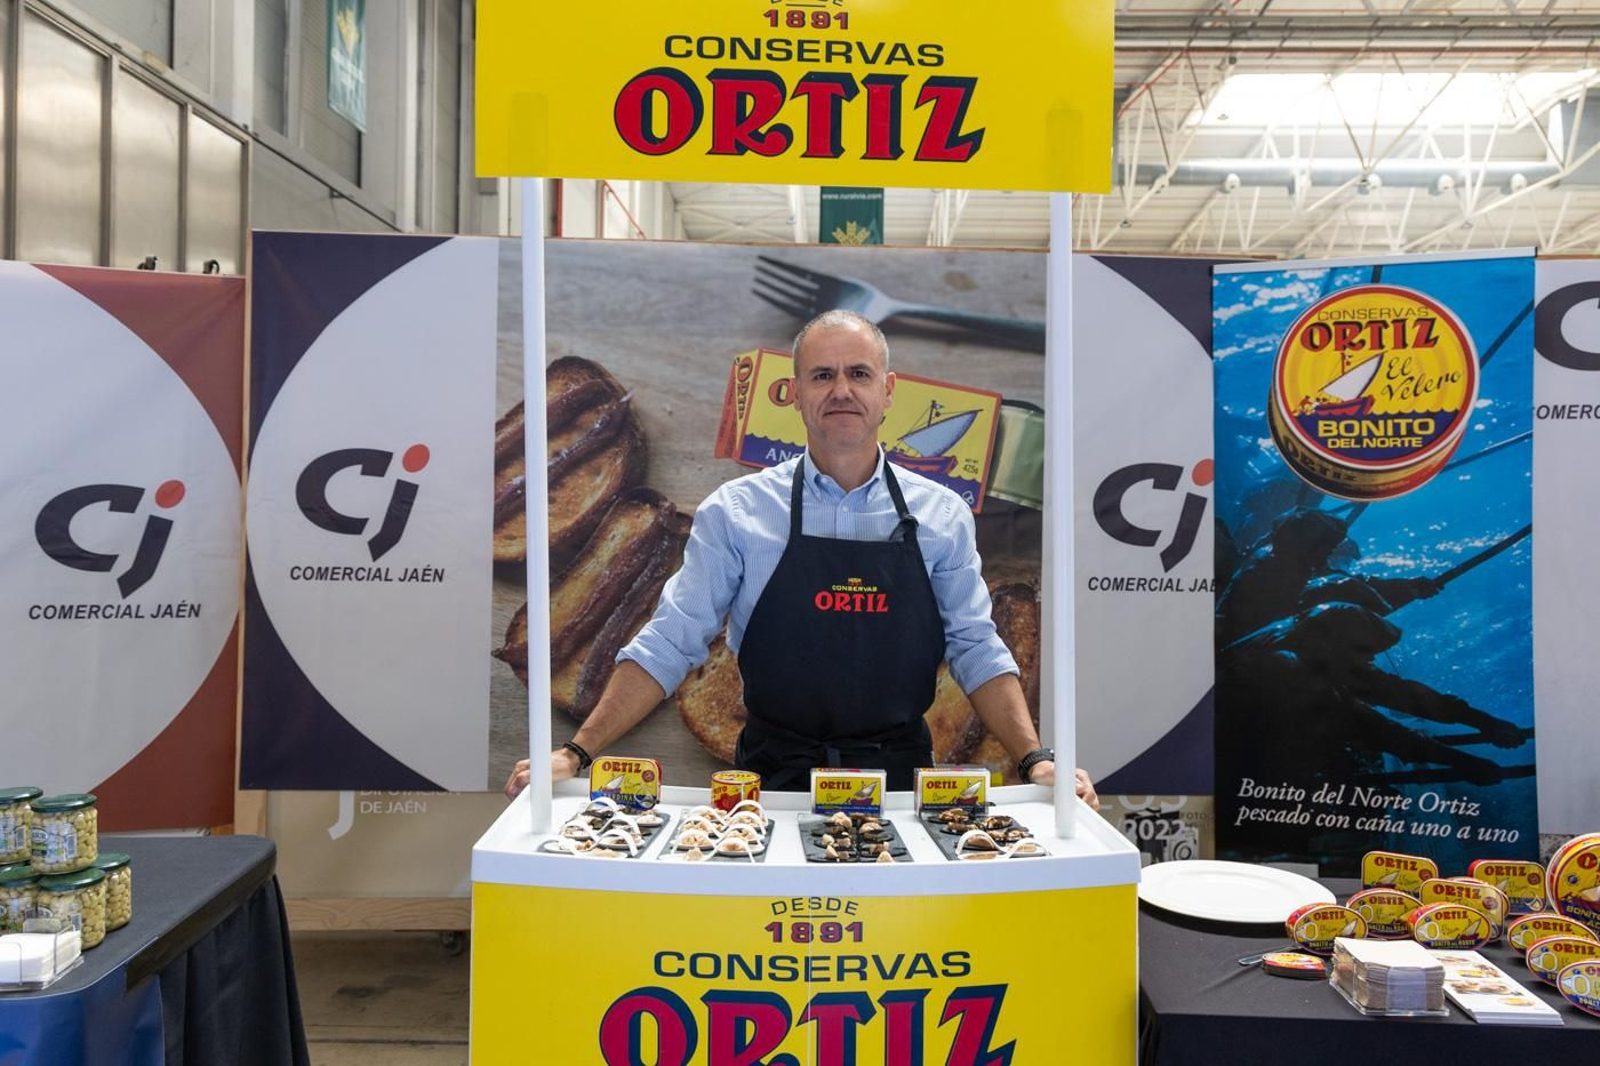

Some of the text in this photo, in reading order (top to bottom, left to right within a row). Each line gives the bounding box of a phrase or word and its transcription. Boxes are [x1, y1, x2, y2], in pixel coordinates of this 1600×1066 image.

[763, 9, 848, 30] 1891
[664, 35, 944, 67] CONSERVAS
[614, 66, 986, 162] ORTIZ
[1317, 306, 1430, 320] CONSERVAS
[1300, 318, 1440, 352] ORTIZ
[1386, 356, 1412, 380] El
[1381, 371, 1462, 403] Velero
[1317, 417, 1436, 438] BONITO
[1327, 436, 1423, 448] DEL NORTE
[290, 564, 445, 583] COMERCIAL JAÉN
[1088, 576, 1185, 592] COMERCIAL
[28, 600, 202, 620] COMERCIAL JAÉN
[815, 591, 889, 612] ORTIZ
[602, 761, 641, 773] ORTIZ
[820, 781, 852, 790] ORTIZ
[926, 781, 957, 789] ORTIZ
[360, 799, 427, 814] DE JAÉN
[1238, 778, 1481, 817] Bonito del Norte Ortiz
[1234, 804, 1311, 826] pescado
[1315, 811, 1350, 828] con
[1355, 814, 1405, 833] caña
[1410, 820, 1451, 837] uno
[1456, 828, 1471, 840] a
[1477, 828, 1520, 844] uno
[1374, 856, 1418, 872] ORTIZ
[1484, 865, 1527, 877] ORTIZ
[1369, 895, 1403, 906] ORTIZ
[1433, 883, 1481, 900] ORTIZ
[771, 896, 859, 915] DESDE
[1313, 910, 1346, 921] ORTIZ
[1434, 910, 1467, 921] ORTIZ
[765, 921, 864, 943] 1891
[1533, 920, 1573, 933] ORTIZ
[1553, 942, 1596, 955] ORTIZ
[653, 950, 972, 983] CONSERVAS
[598, 983, 1017, 1066] ORTIZ
